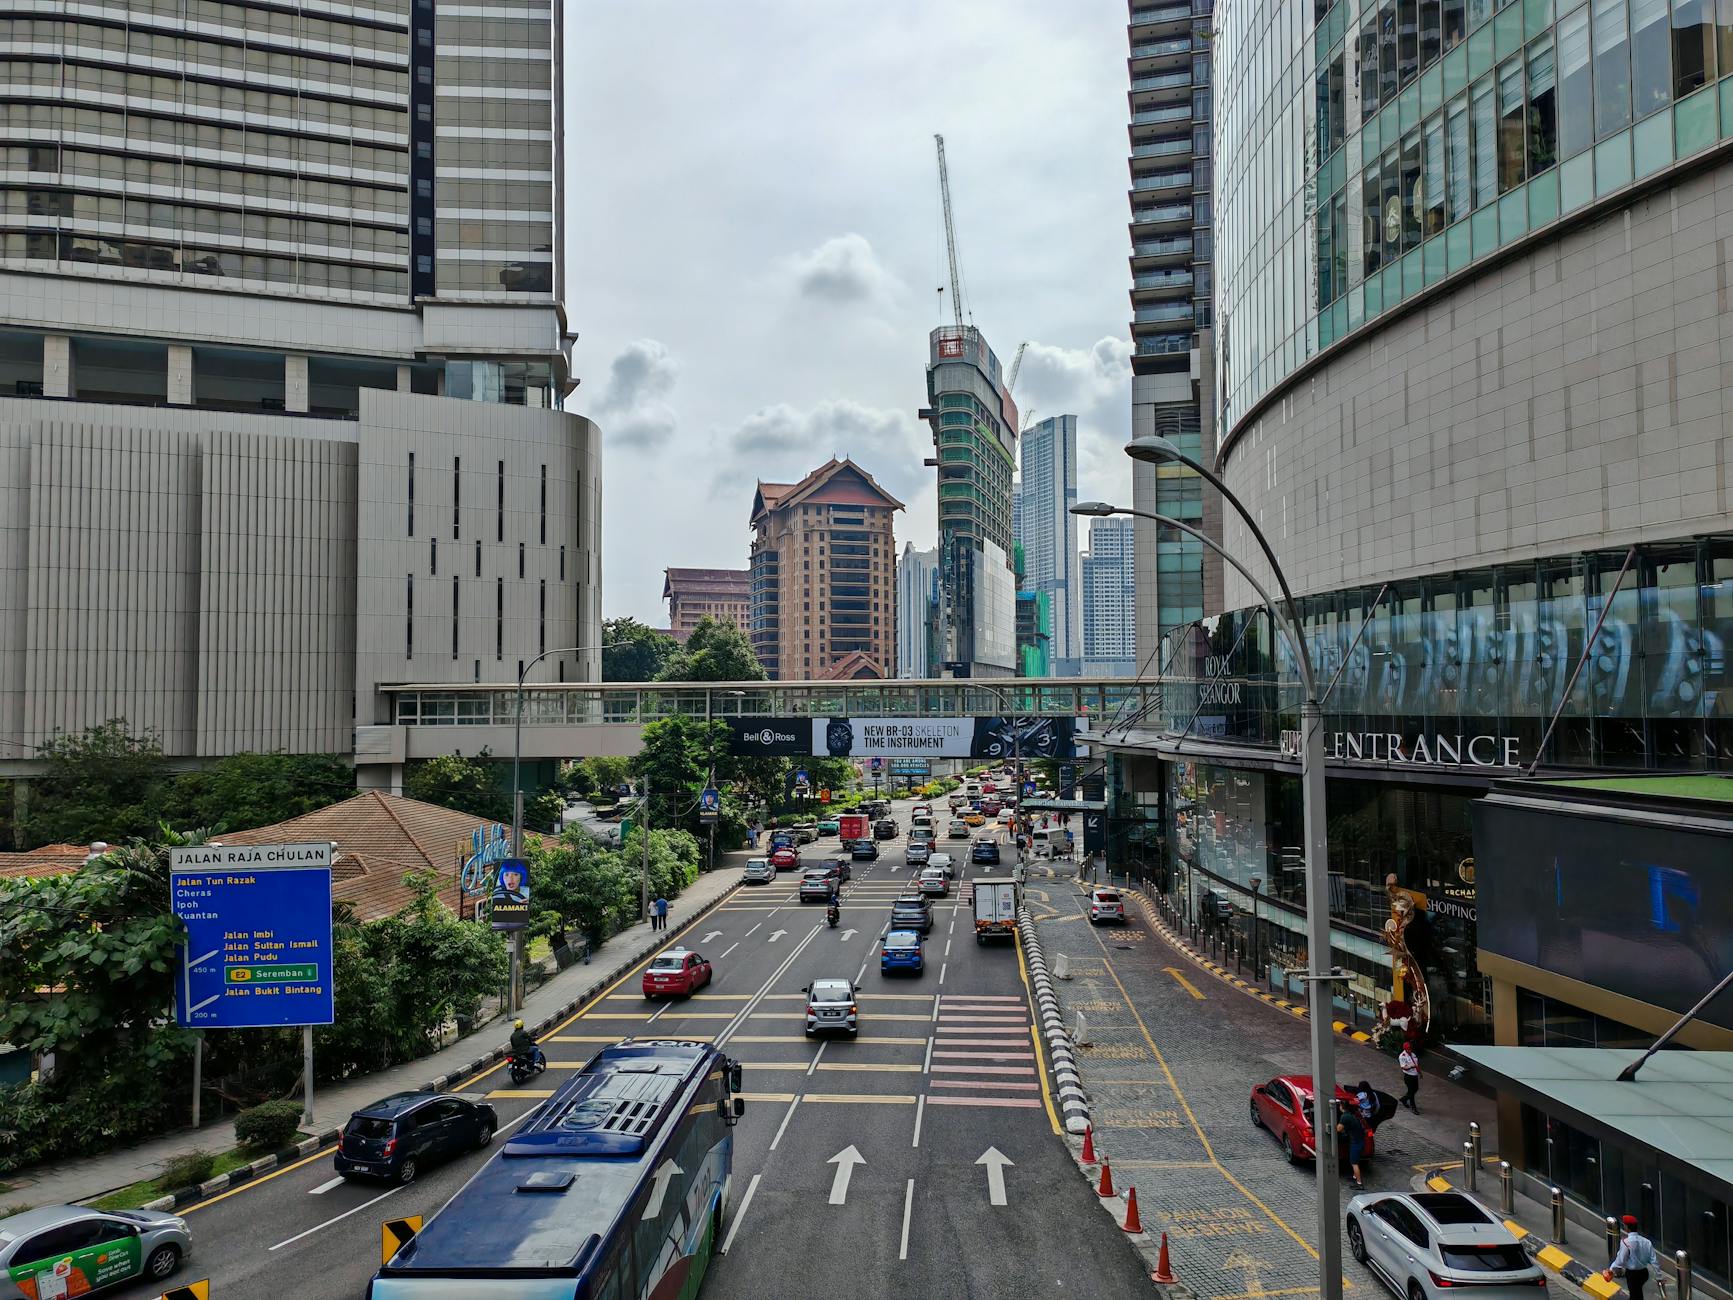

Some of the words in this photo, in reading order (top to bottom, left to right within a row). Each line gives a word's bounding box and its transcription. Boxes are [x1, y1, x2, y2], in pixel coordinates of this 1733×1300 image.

[1205, 655, 1231, 676] ROYAL
[864, 726, 884, 736] NEW
[886, 726, 912, 736] BR-03
[915, 726, 959, 736] SKELETON
[744, 732, 759, 741] Bell
[775, 732, 796, 741] Ross
[864, 738, 885, 748] TIME
[888, 738, 944, 748] INSTRUMENT
[1334, 732, 1521, 767] ENTRANCE
[178, 853, 222, 864] JALAN
[228, 852, 262, 862] RAJA
[267, 850, 324, 861] CHULAN
[177, 878, 202, 886] Jalan
[206, 877, 223, 885] Tun
[227, 876, 256, 884] Razak
[1427, 898, 1477, 921] SHOPPING
[224, 931, 248, 939] Jalan
[290, 940, 318, 948] Ismail
[225, 988, 250, 996] Jalan
[255, 987, 280, 995] Bukit
[285, 986, 322, 994] Bintang
